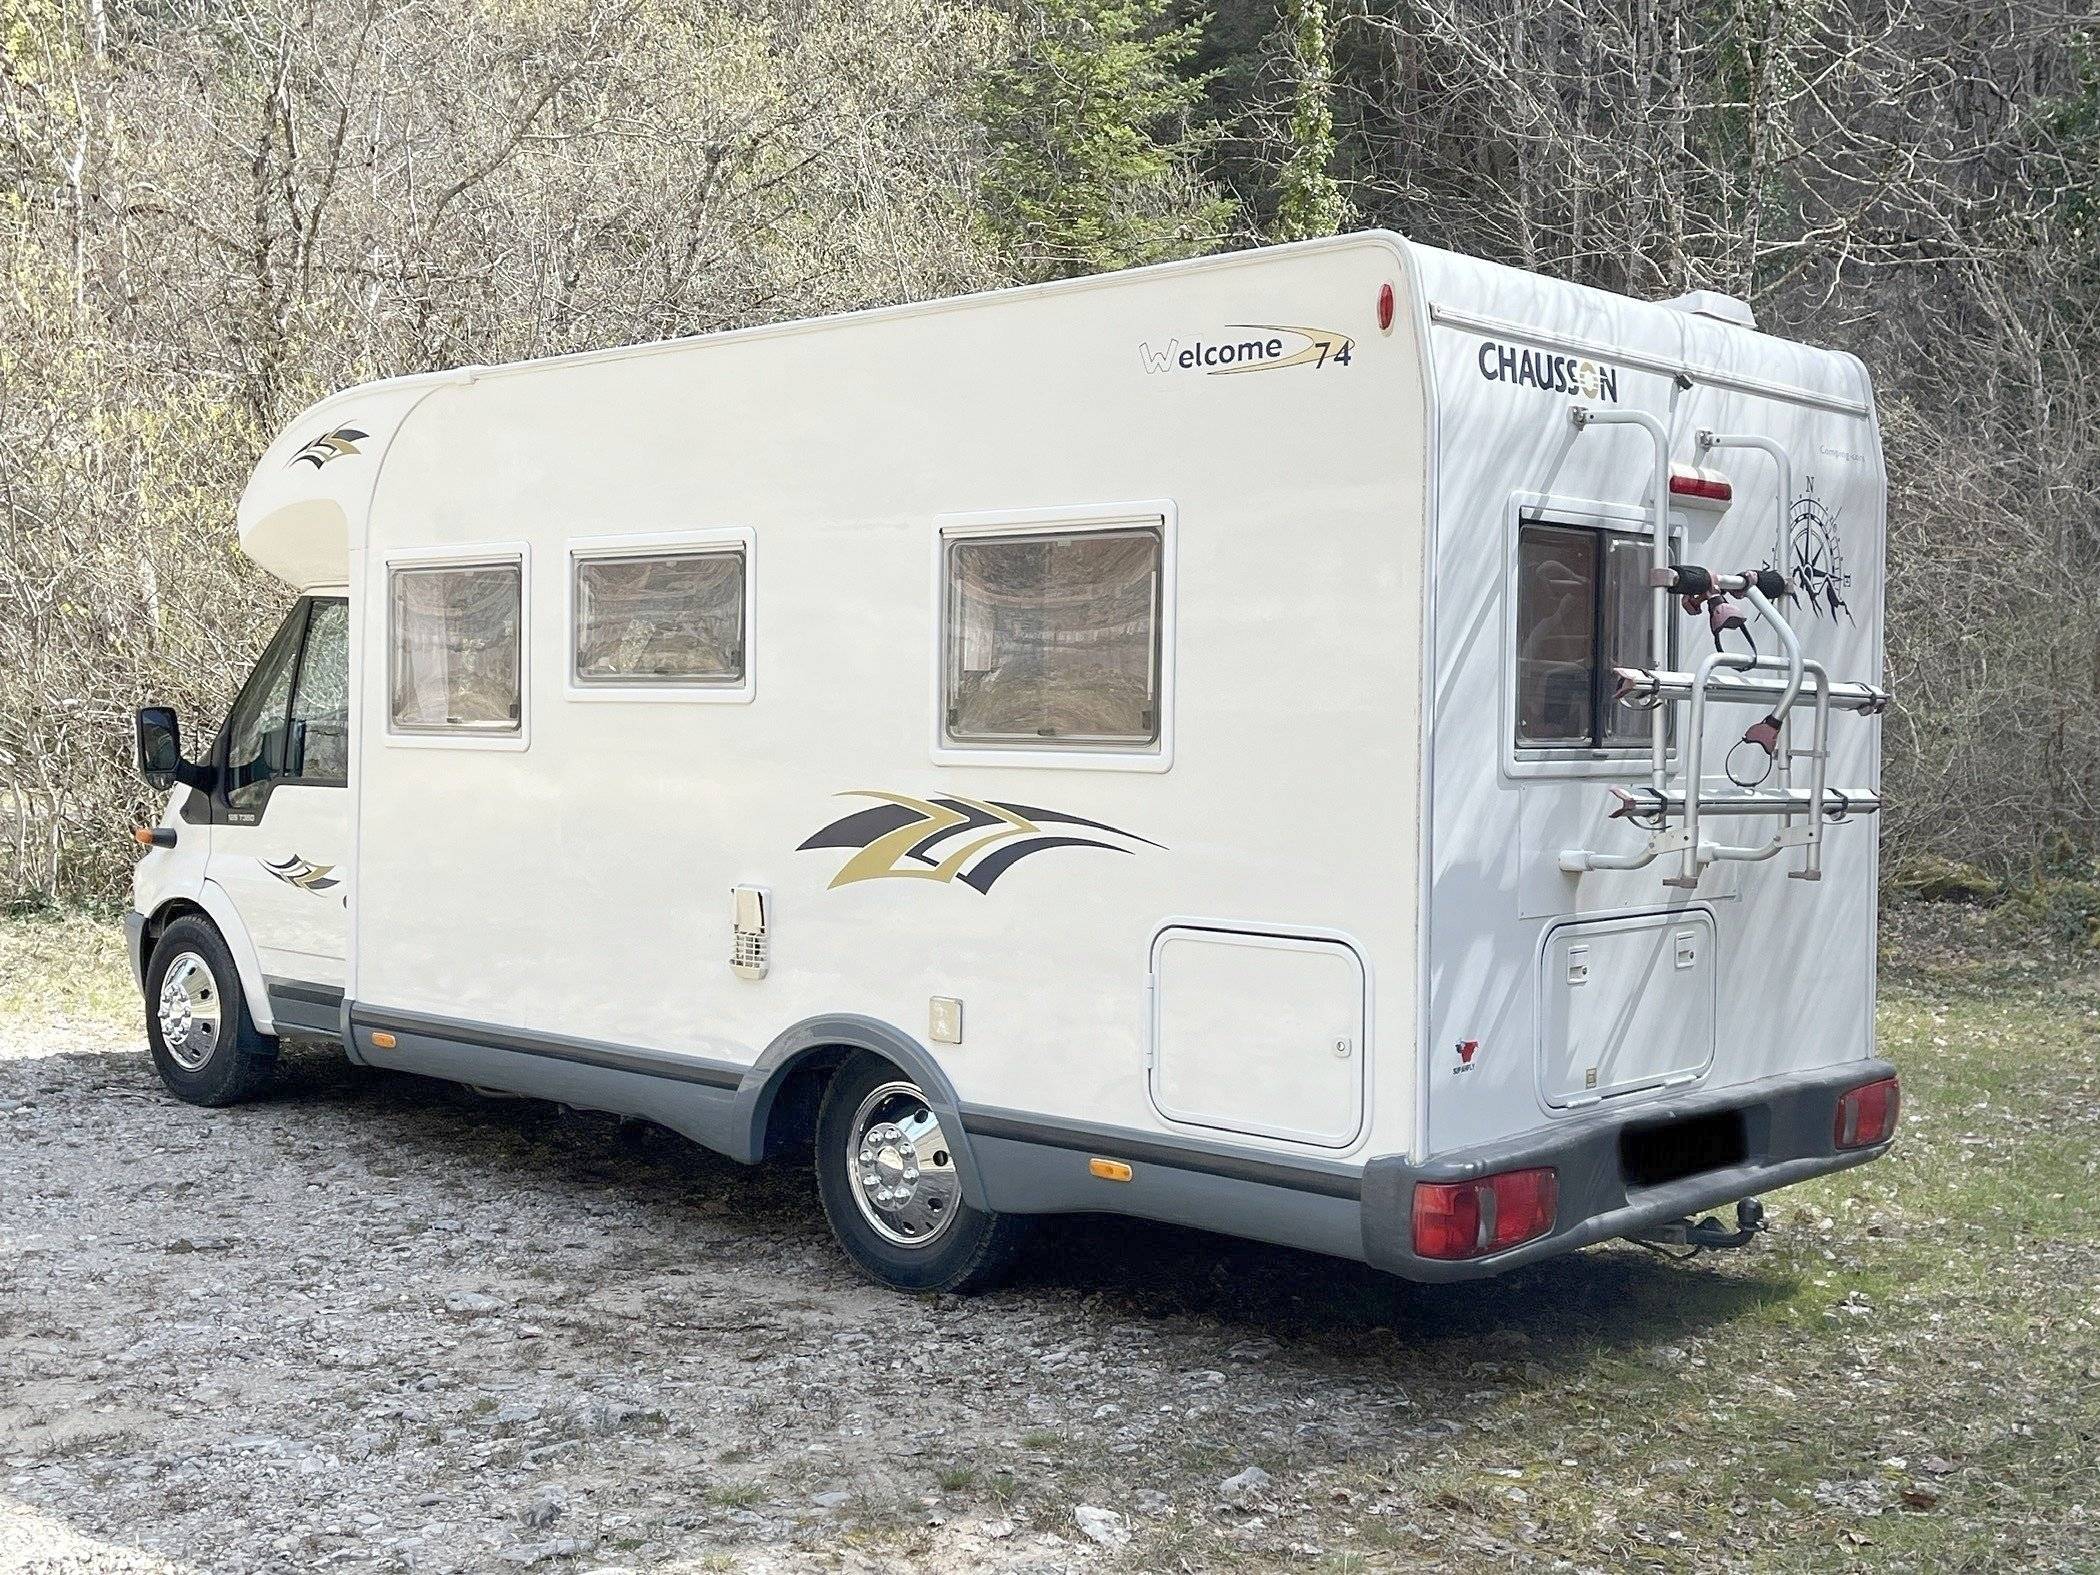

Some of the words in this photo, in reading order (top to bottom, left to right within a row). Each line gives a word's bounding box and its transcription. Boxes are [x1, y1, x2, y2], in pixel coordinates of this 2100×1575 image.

[1138, 337, 1283, 375] Welcome
[1315, 340, 1352, 369] 74
[1478, 341, 1618, 403] CHAUSSON
[1805, 475, 1815, 493] N
